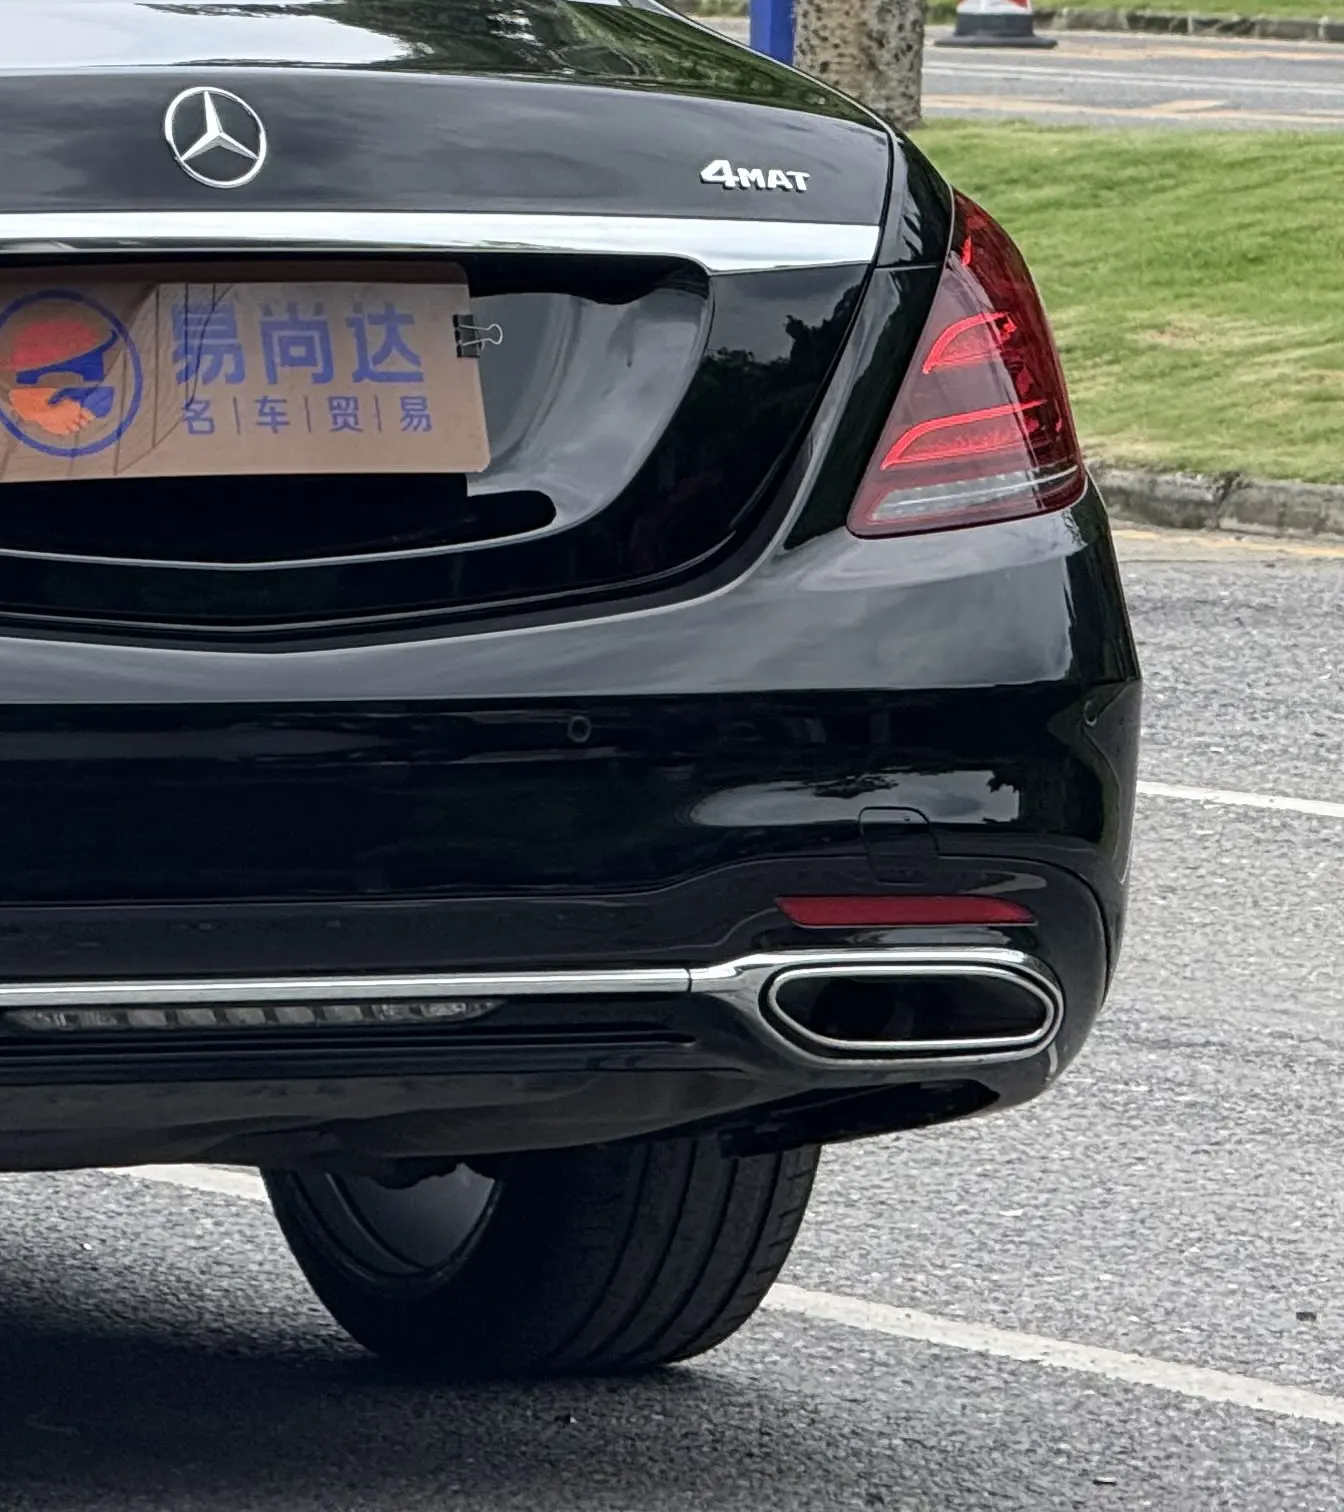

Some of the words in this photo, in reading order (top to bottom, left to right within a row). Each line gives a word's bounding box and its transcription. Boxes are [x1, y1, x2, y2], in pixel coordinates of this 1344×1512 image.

[700, 159, 811, 192] 4MAT
[171, 299, 426, 386] 易尚达
